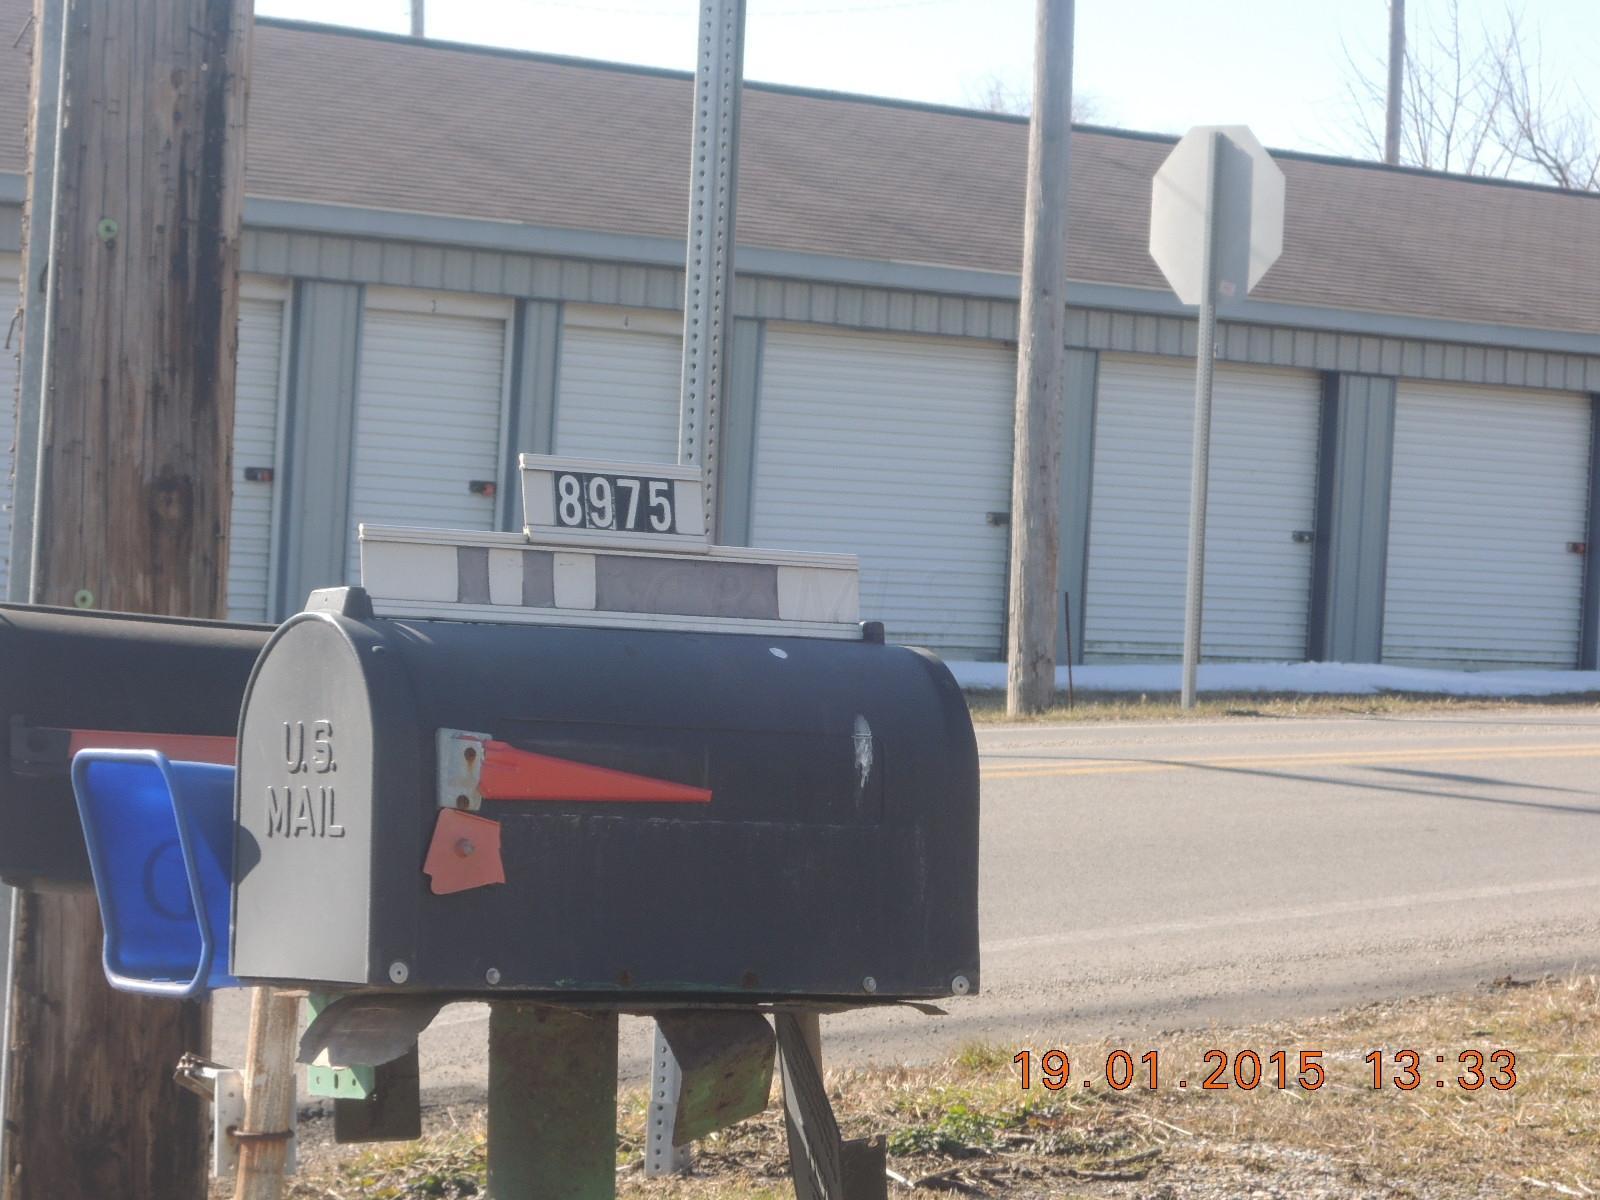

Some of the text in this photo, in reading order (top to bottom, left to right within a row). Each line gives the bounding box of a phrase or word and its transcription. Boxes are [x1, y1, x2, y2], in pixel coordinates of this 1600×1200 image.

[558, 474, 672, 532] 8975
[282, 719, 338, 775] U.S.
[266, 785, 346, 838] MAIL
